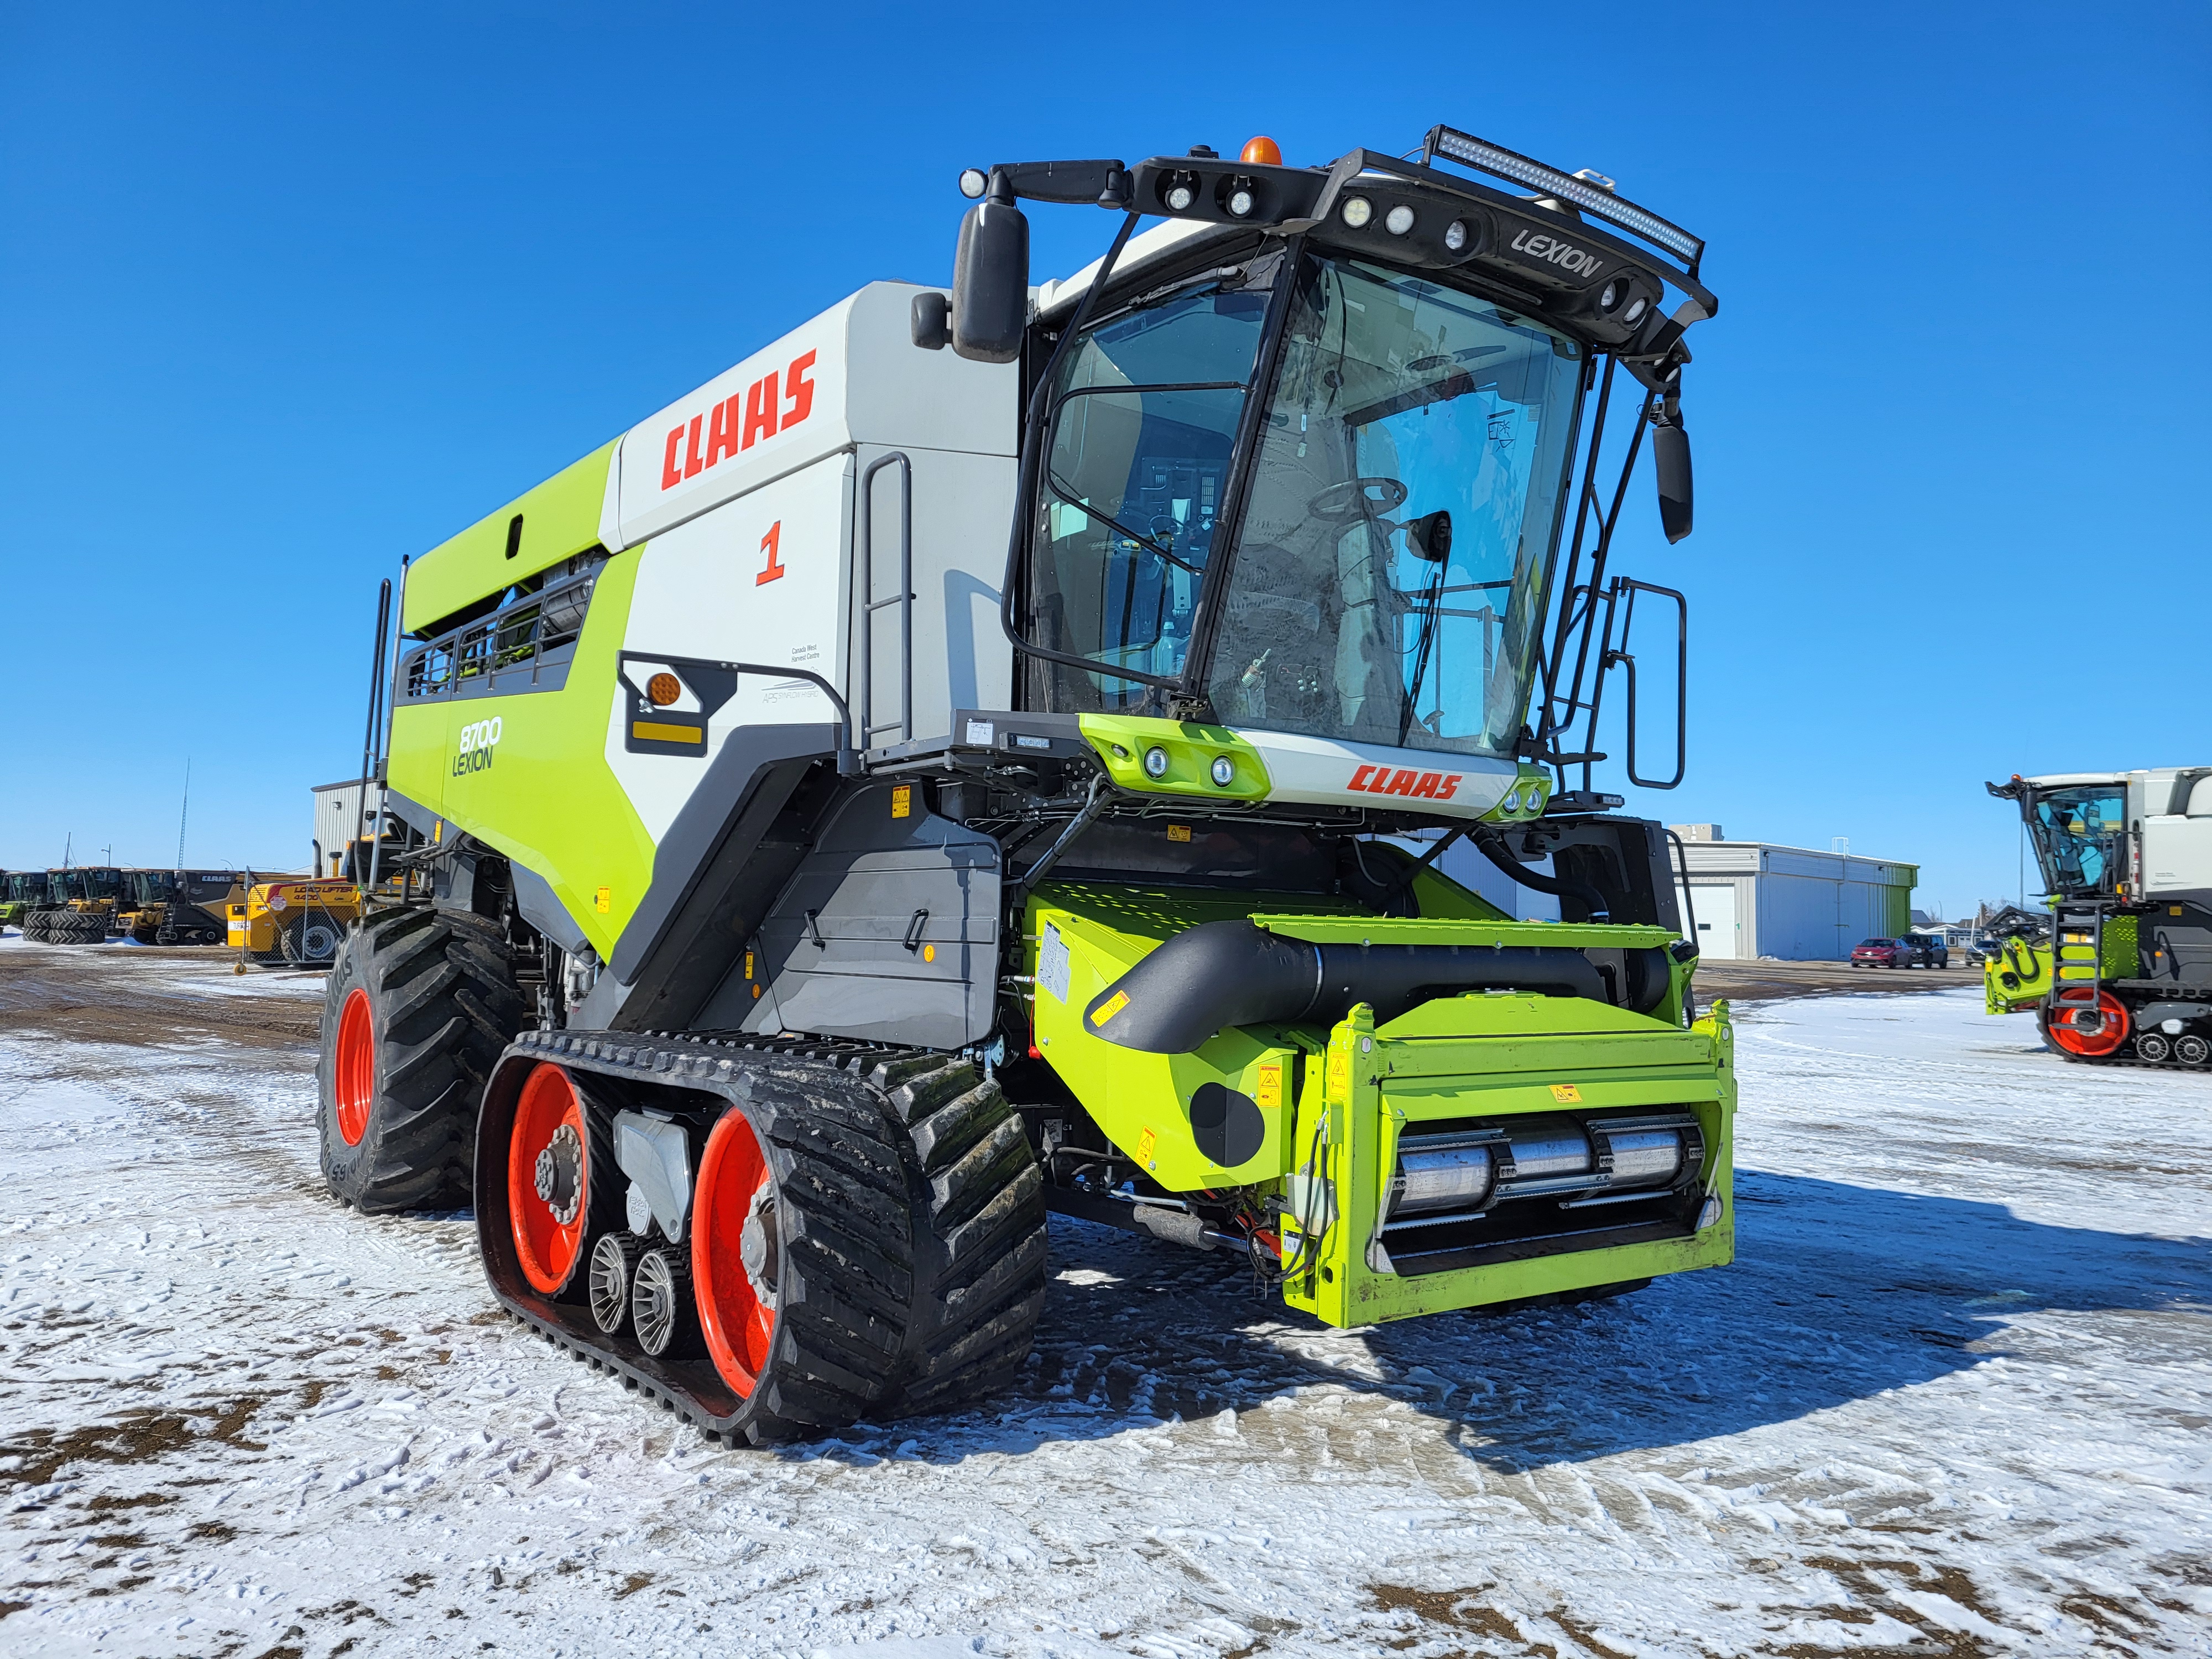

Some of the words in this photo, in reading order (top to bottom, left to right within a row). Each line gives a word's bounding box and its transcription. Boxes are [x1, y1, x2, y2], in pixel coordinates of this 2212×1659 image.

[1511, 229, 1603, 278] LEXION
[661, 347, 817, 492] CLAAS
[755, 520, 785, 587] 1
[791, 654, 806, 662] Harvest
[792, 646, 806, 654] Canada
[763, 692, 778, 703] APS
[460, 716, 502, 754] 8700
[453, 745, 493, 777] LEXION
[1347, 765, 1463, 800] CLAAS
